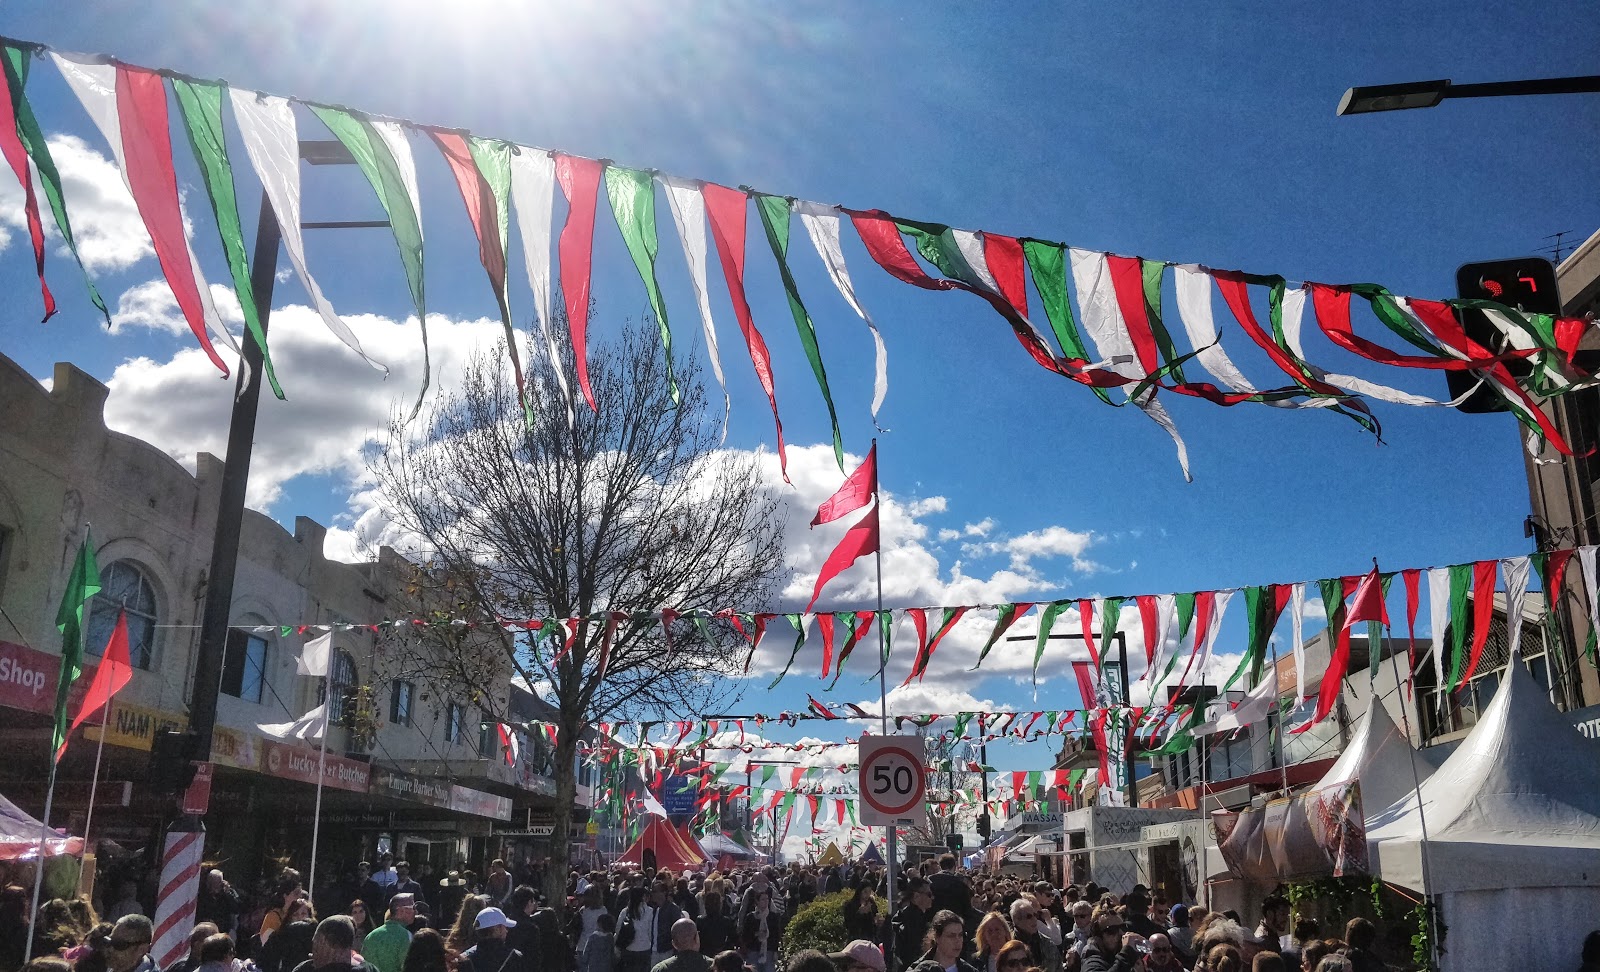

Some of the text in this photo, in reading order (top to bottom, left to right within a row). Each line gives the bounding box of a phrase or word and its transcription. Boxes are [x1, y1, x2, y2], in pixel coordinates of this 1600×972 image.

[0, 657, 46, 696] Shop
[116, 708, 150, 739] NAM
[1573, 719, 1600, 739] OTE
[288, 751, 367, 784] Lucky Str Butcher
[873, 765, 912, 795] 50
[388, 772, 449, 803] Empire Barber Shop
